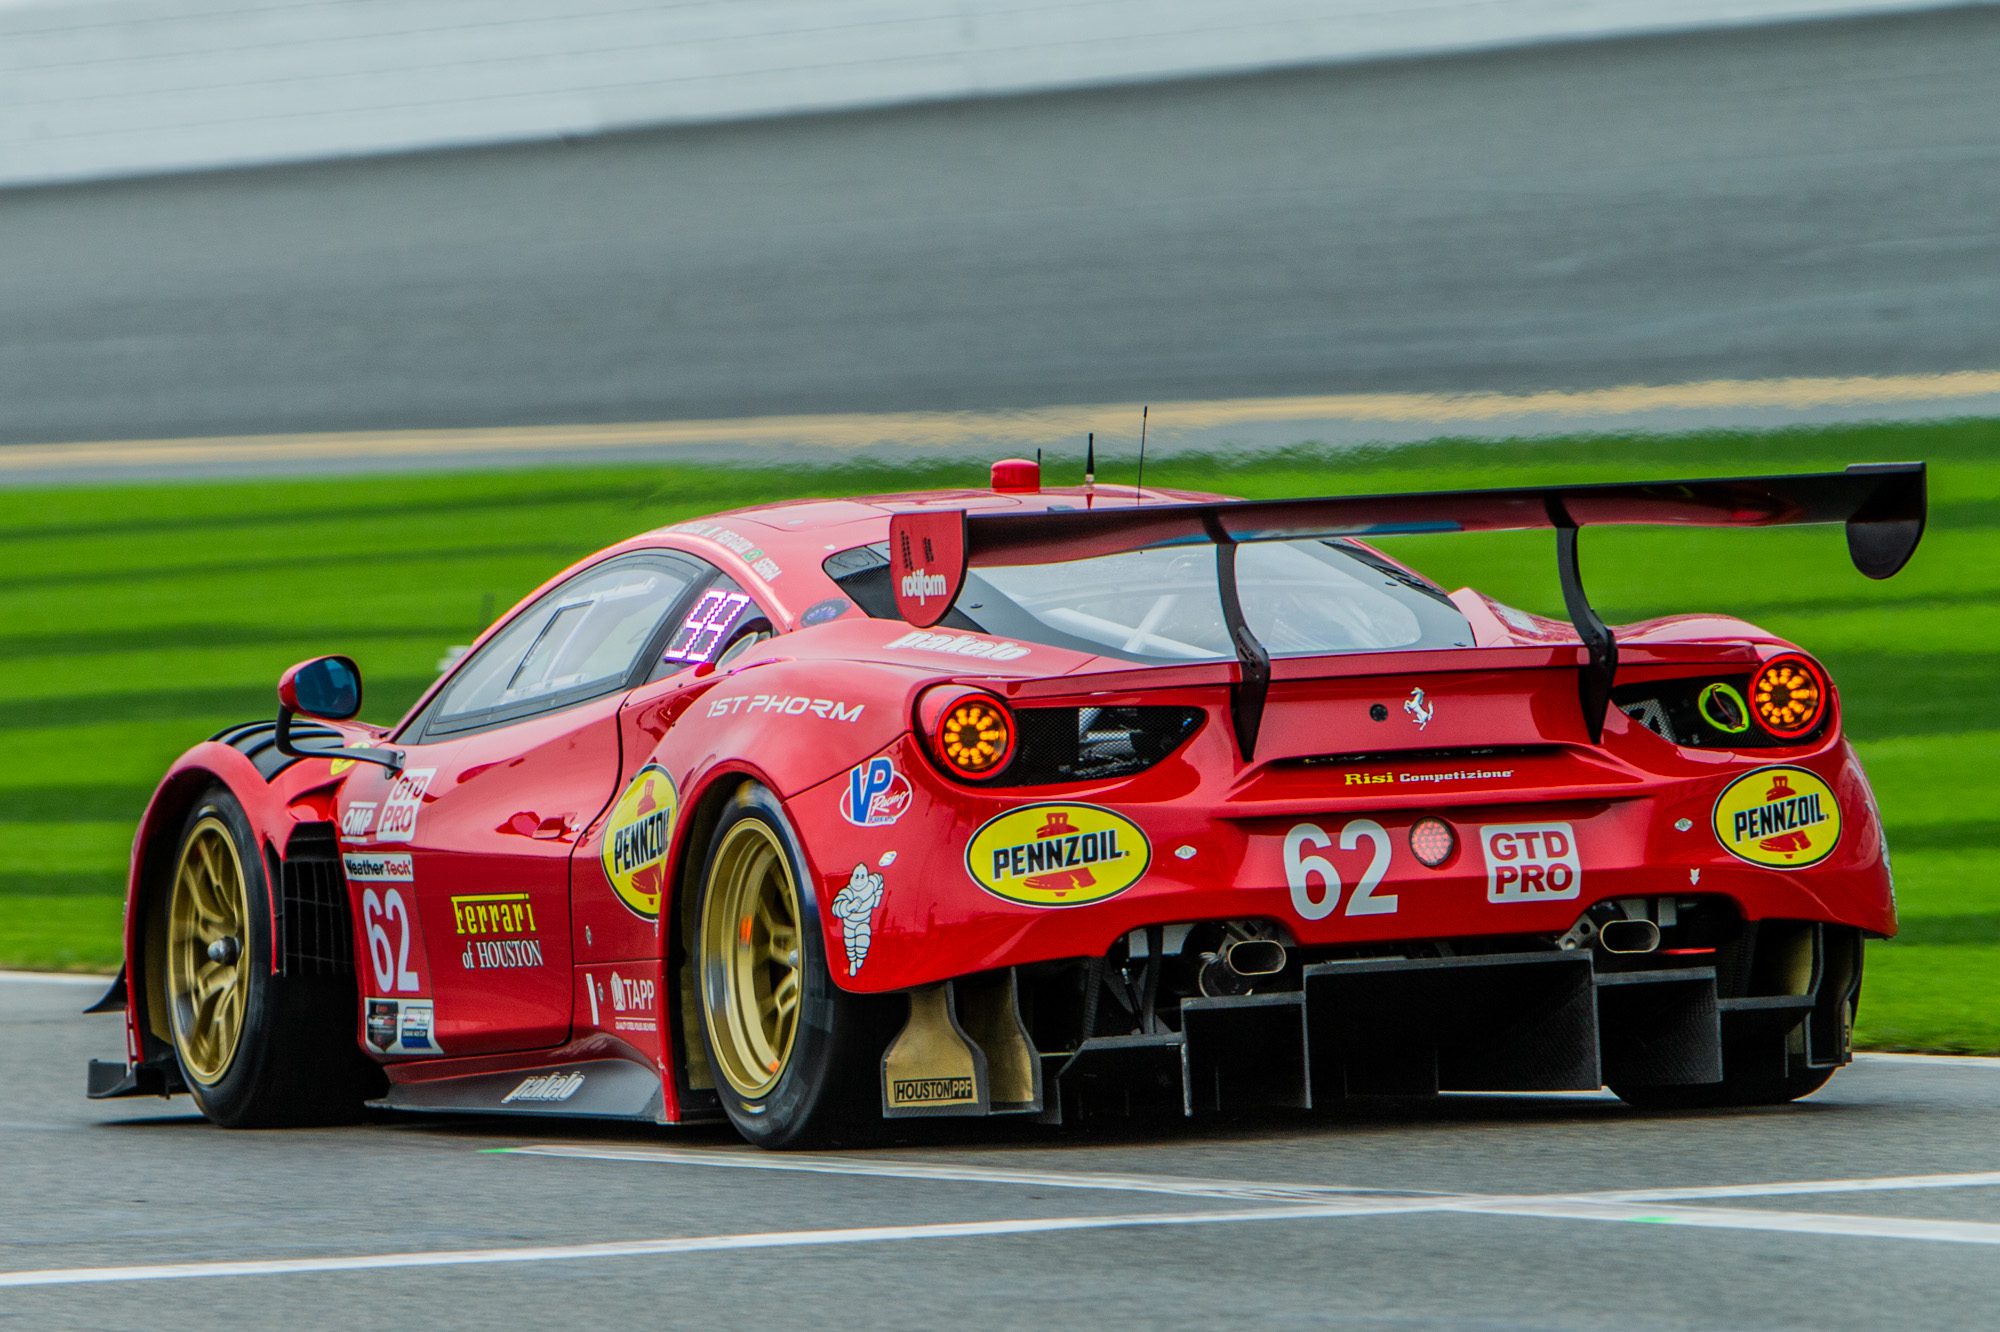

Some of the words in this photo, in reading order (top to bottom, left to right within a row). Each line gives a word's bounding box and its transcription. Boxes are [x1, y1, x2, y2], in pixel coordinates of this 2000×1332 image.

[902, 568, 946, 606] rotiform
[664, 590, 751, 663] 99
[883, 630, 1031, 661] pakelo
[707, 696, 748, 718] 1ST
[747, 695, 865, 722] PHORM
[394, 775, 426, 801] GTD
[850, 757, 894, 824] VP
[1345, 772, 1394, 785] Risi
[1399, 769, 1512, 783] Competizione
[342, 808, 373, 835] OMP
[380, 805, 414, 833] PRO
[1734, 793, 1825, 842] PENNZOIL
[993, 829, 1123, 880] PENNZOIL
[1489, 831, 1569, 861] GTD
[1283, 819, 1398, 920] 62
[1495, 863, 1573, 894] PRO
[451, 893, 536, 934] Ferrari
[363, 888, 419, 993] 62
[462, 941, 475, 969] of
[476, 940, 544, 968] HOUSTON
[623, 979, 655, 1010] TAPP
[896, 1081, 950, 1100] HOUSTON
[952, 1080, 972, 1097] PPF
